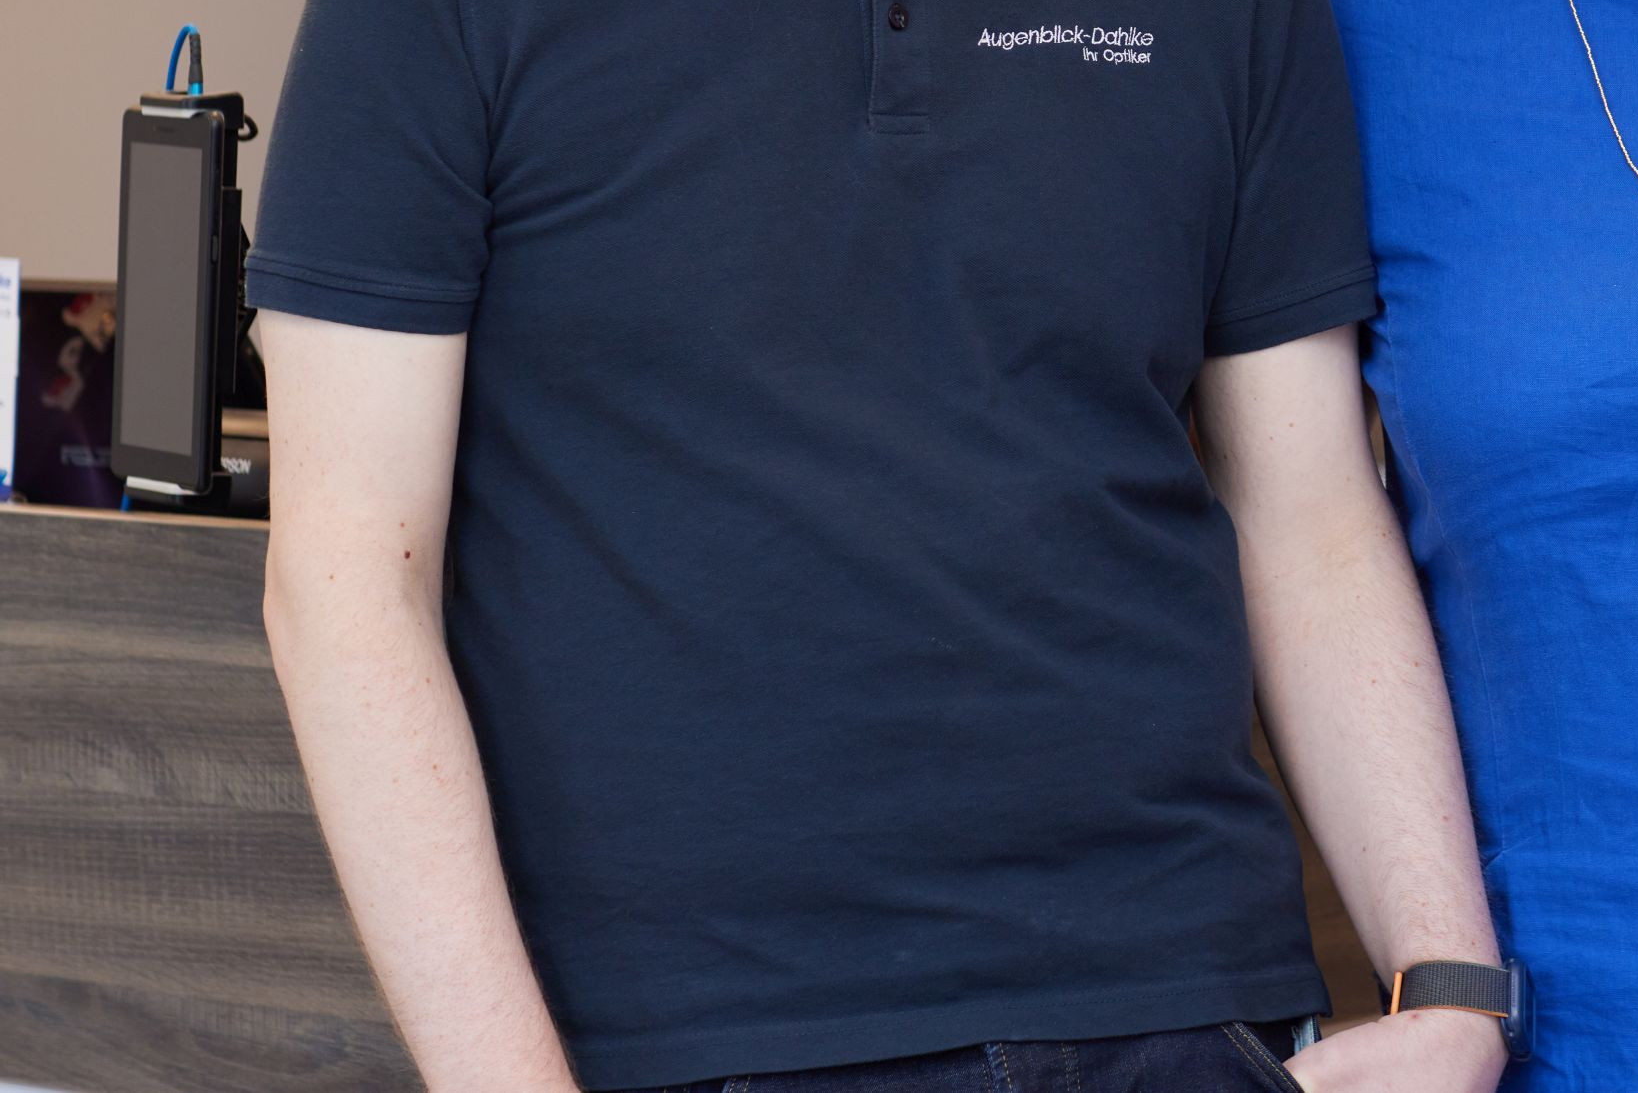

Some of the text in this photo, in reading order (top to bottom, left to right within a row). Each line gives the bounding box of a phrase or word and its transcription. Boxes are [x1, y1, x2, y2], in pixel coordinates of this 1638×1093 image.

[977, 24, 1154, 51] Augenblick-Dahlke
[1082, 46, 1152, 65] Ihr Optiker
